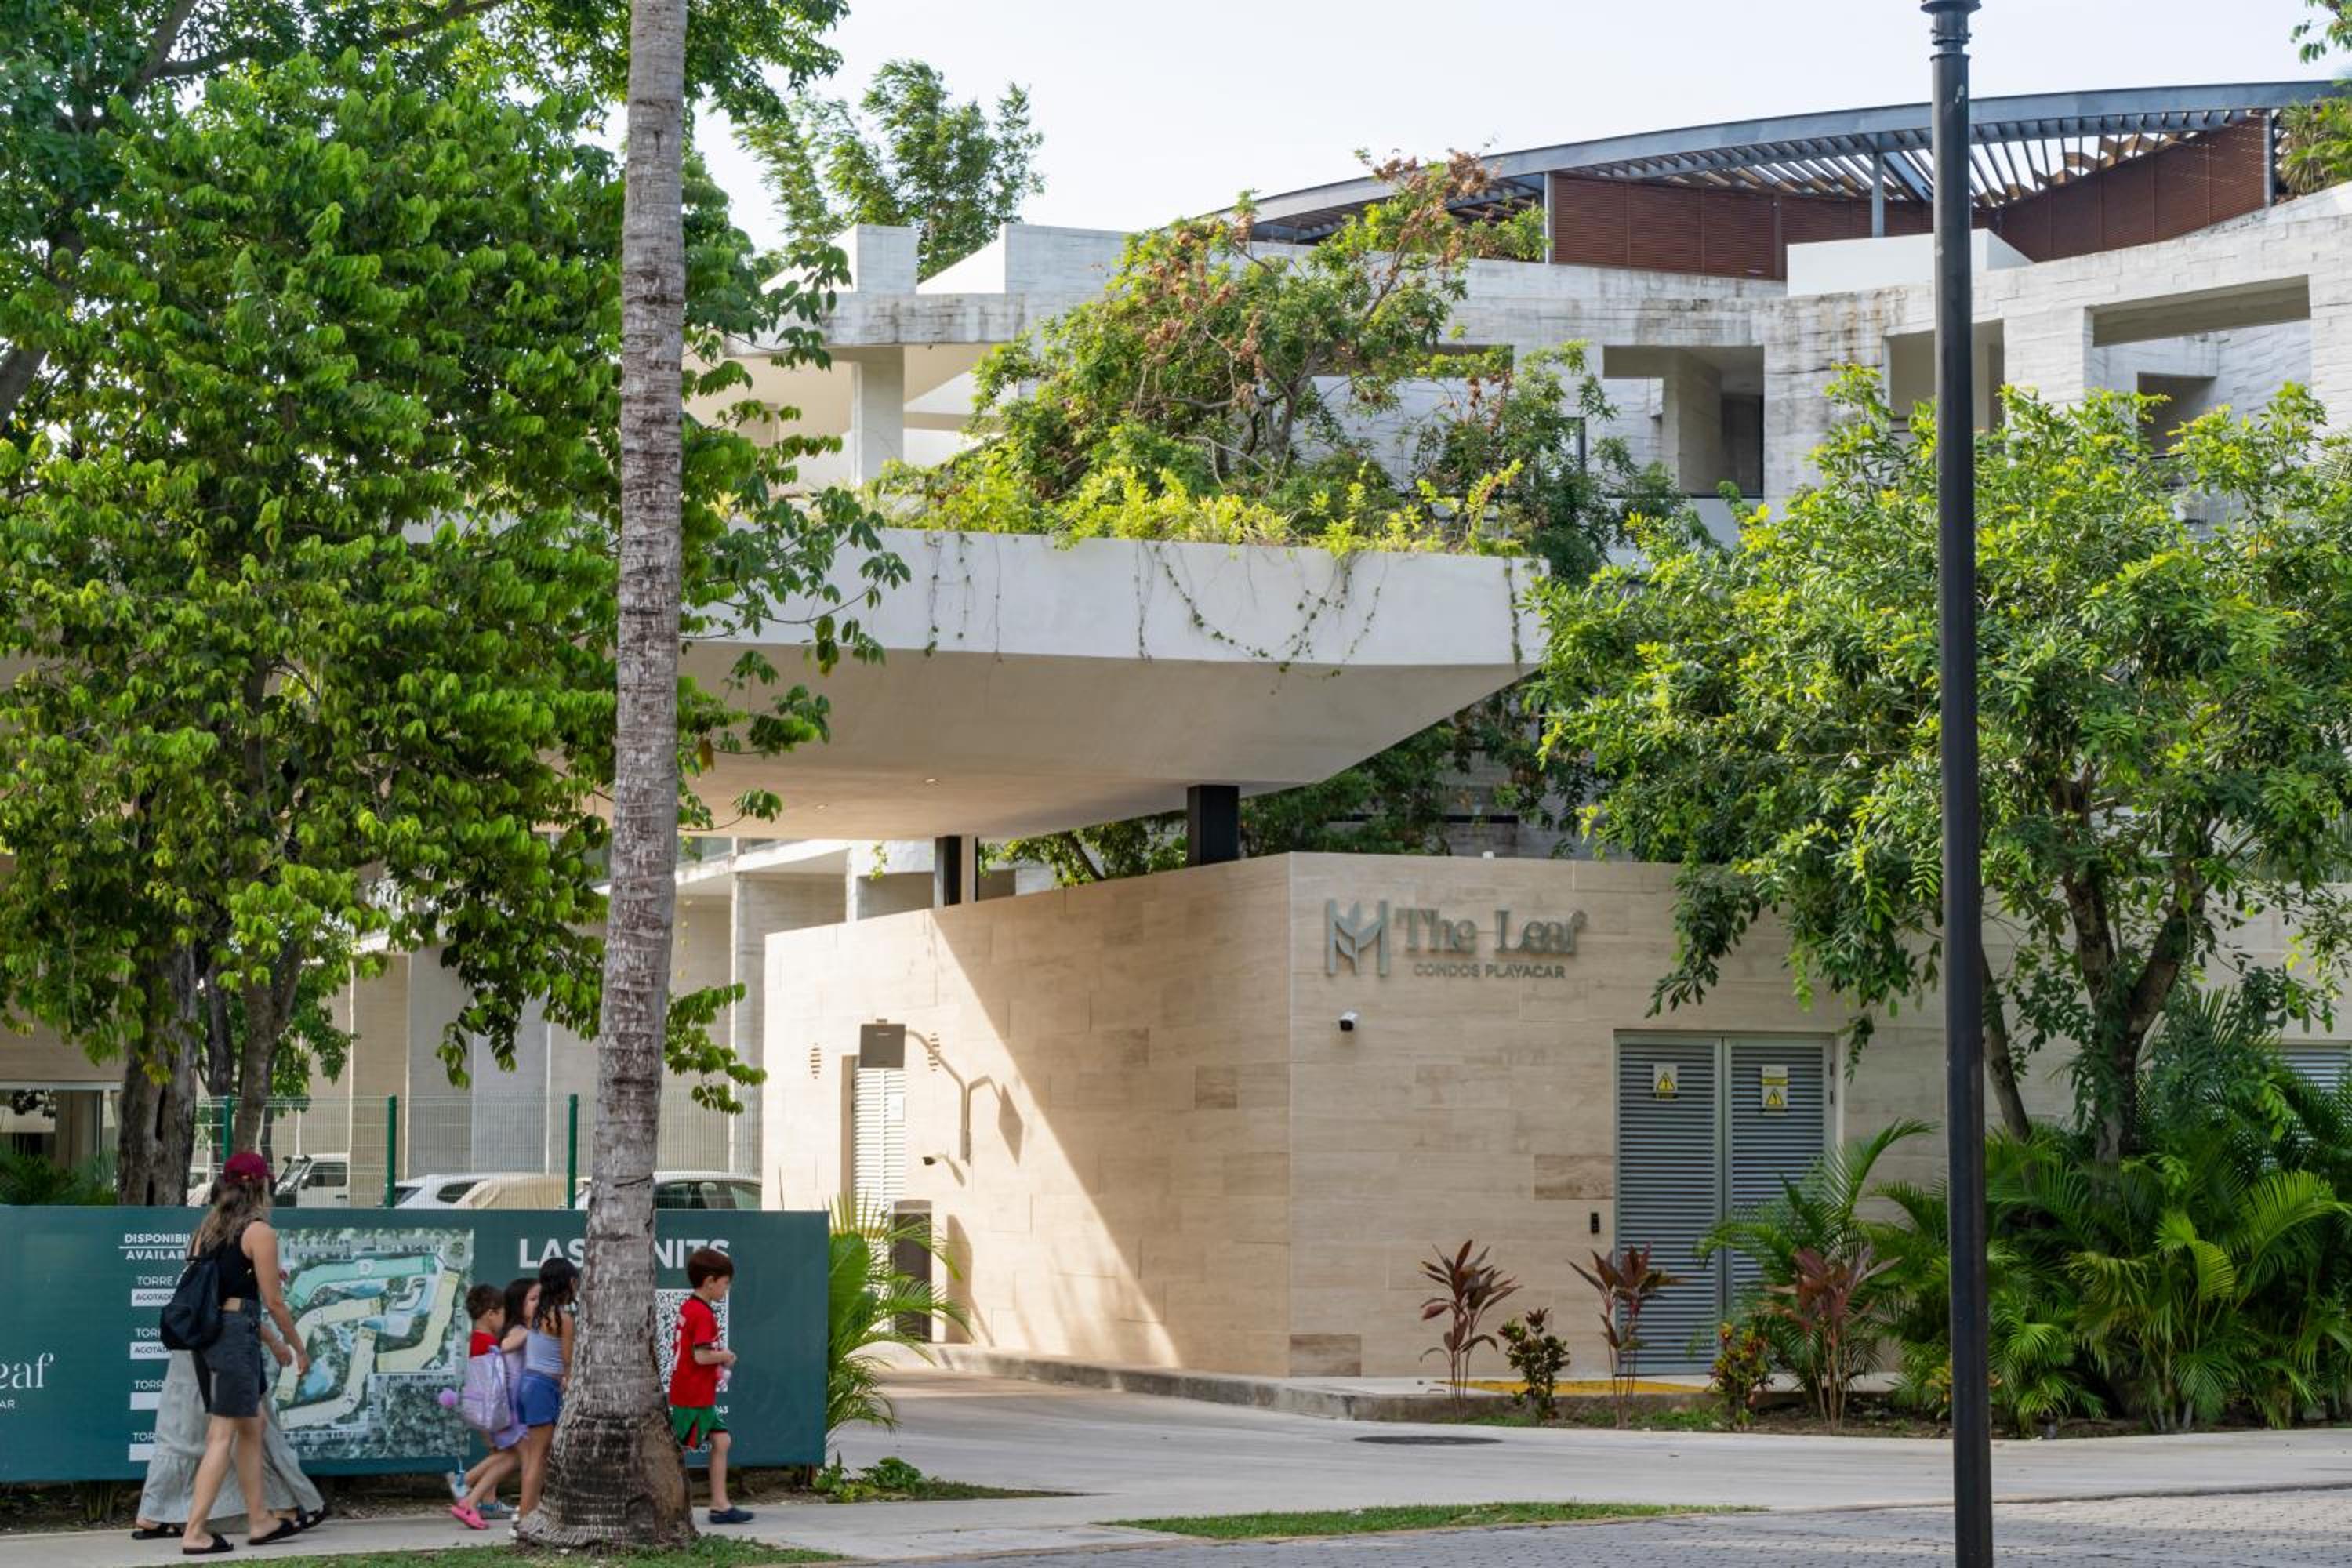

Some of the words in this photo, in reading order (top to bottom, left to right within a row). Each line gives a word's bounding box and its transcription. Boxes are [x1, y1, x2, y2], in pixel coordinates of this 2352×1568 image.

[1396, 908, 1477, 954] The
[1495, 909, 1587, 955] Leaf
[1414, 964, 1479, 978] CONDOS
[1485, 964, 1566, 979] PLAYACAR
[137, 1276, 173, 1286] TORRE
